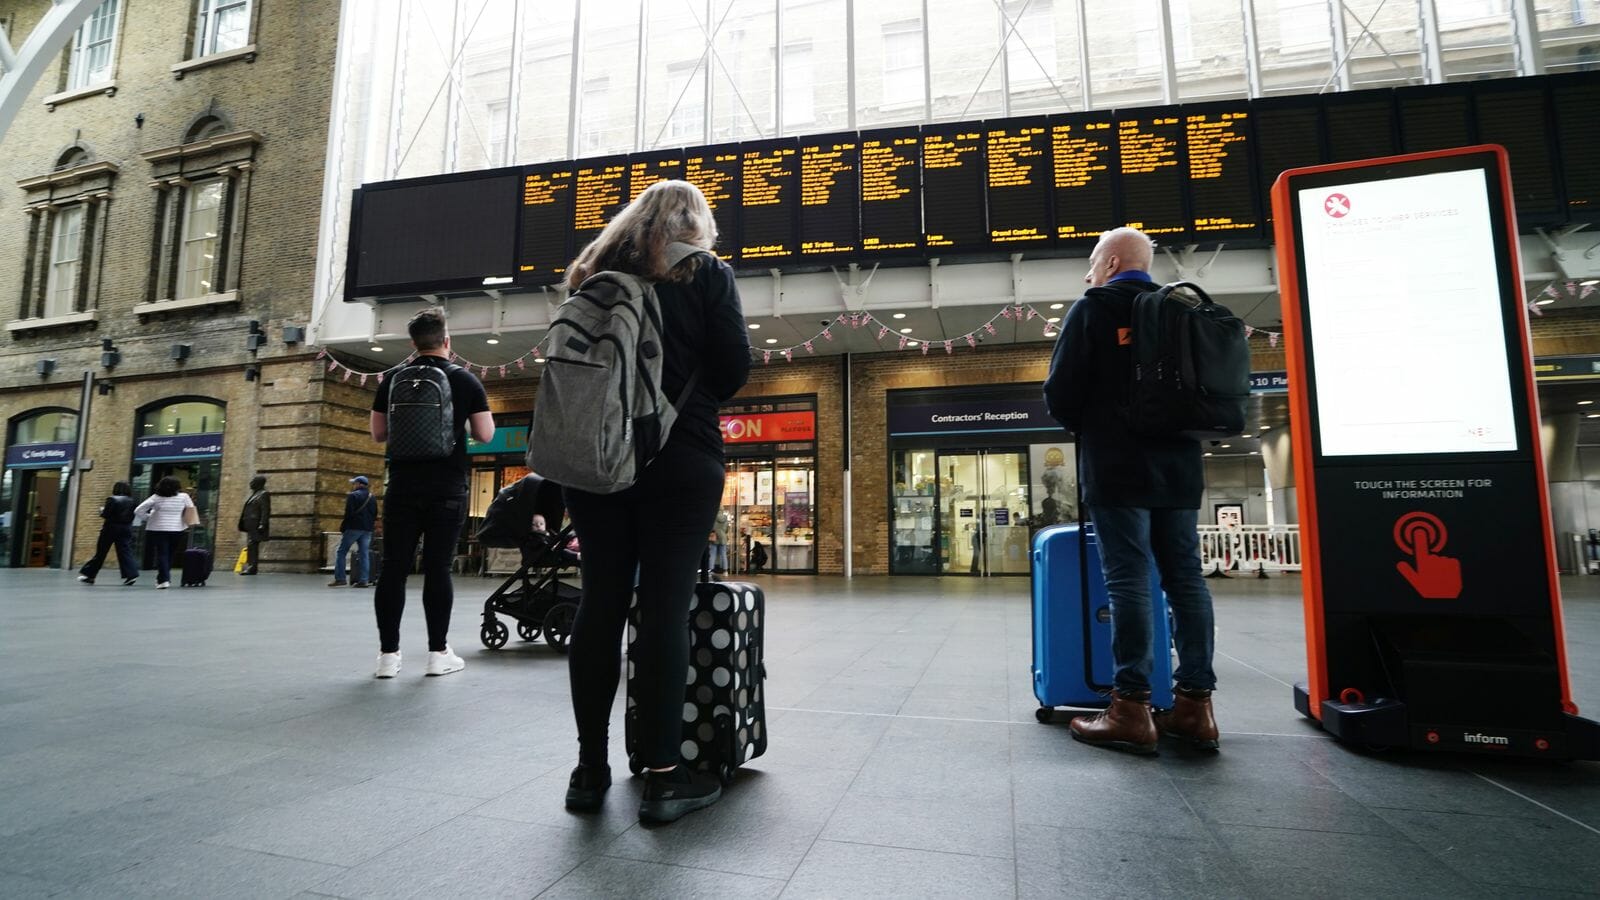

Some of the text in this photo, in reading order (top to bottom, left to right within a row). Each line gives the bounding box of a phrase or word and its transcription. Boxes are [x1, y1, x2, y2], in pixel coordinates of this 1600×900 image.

[1256, 378, 1269, 386] 10
[984, 410, 1029, 422] Reception
[719, 418, 762, 439] EON
[1354, 479, 1492, 489] TOUCH THE SCREEN FOR
[1383, 490, 1464, 499] INFORMATION
[1464, 732, 1509, 744] inform
